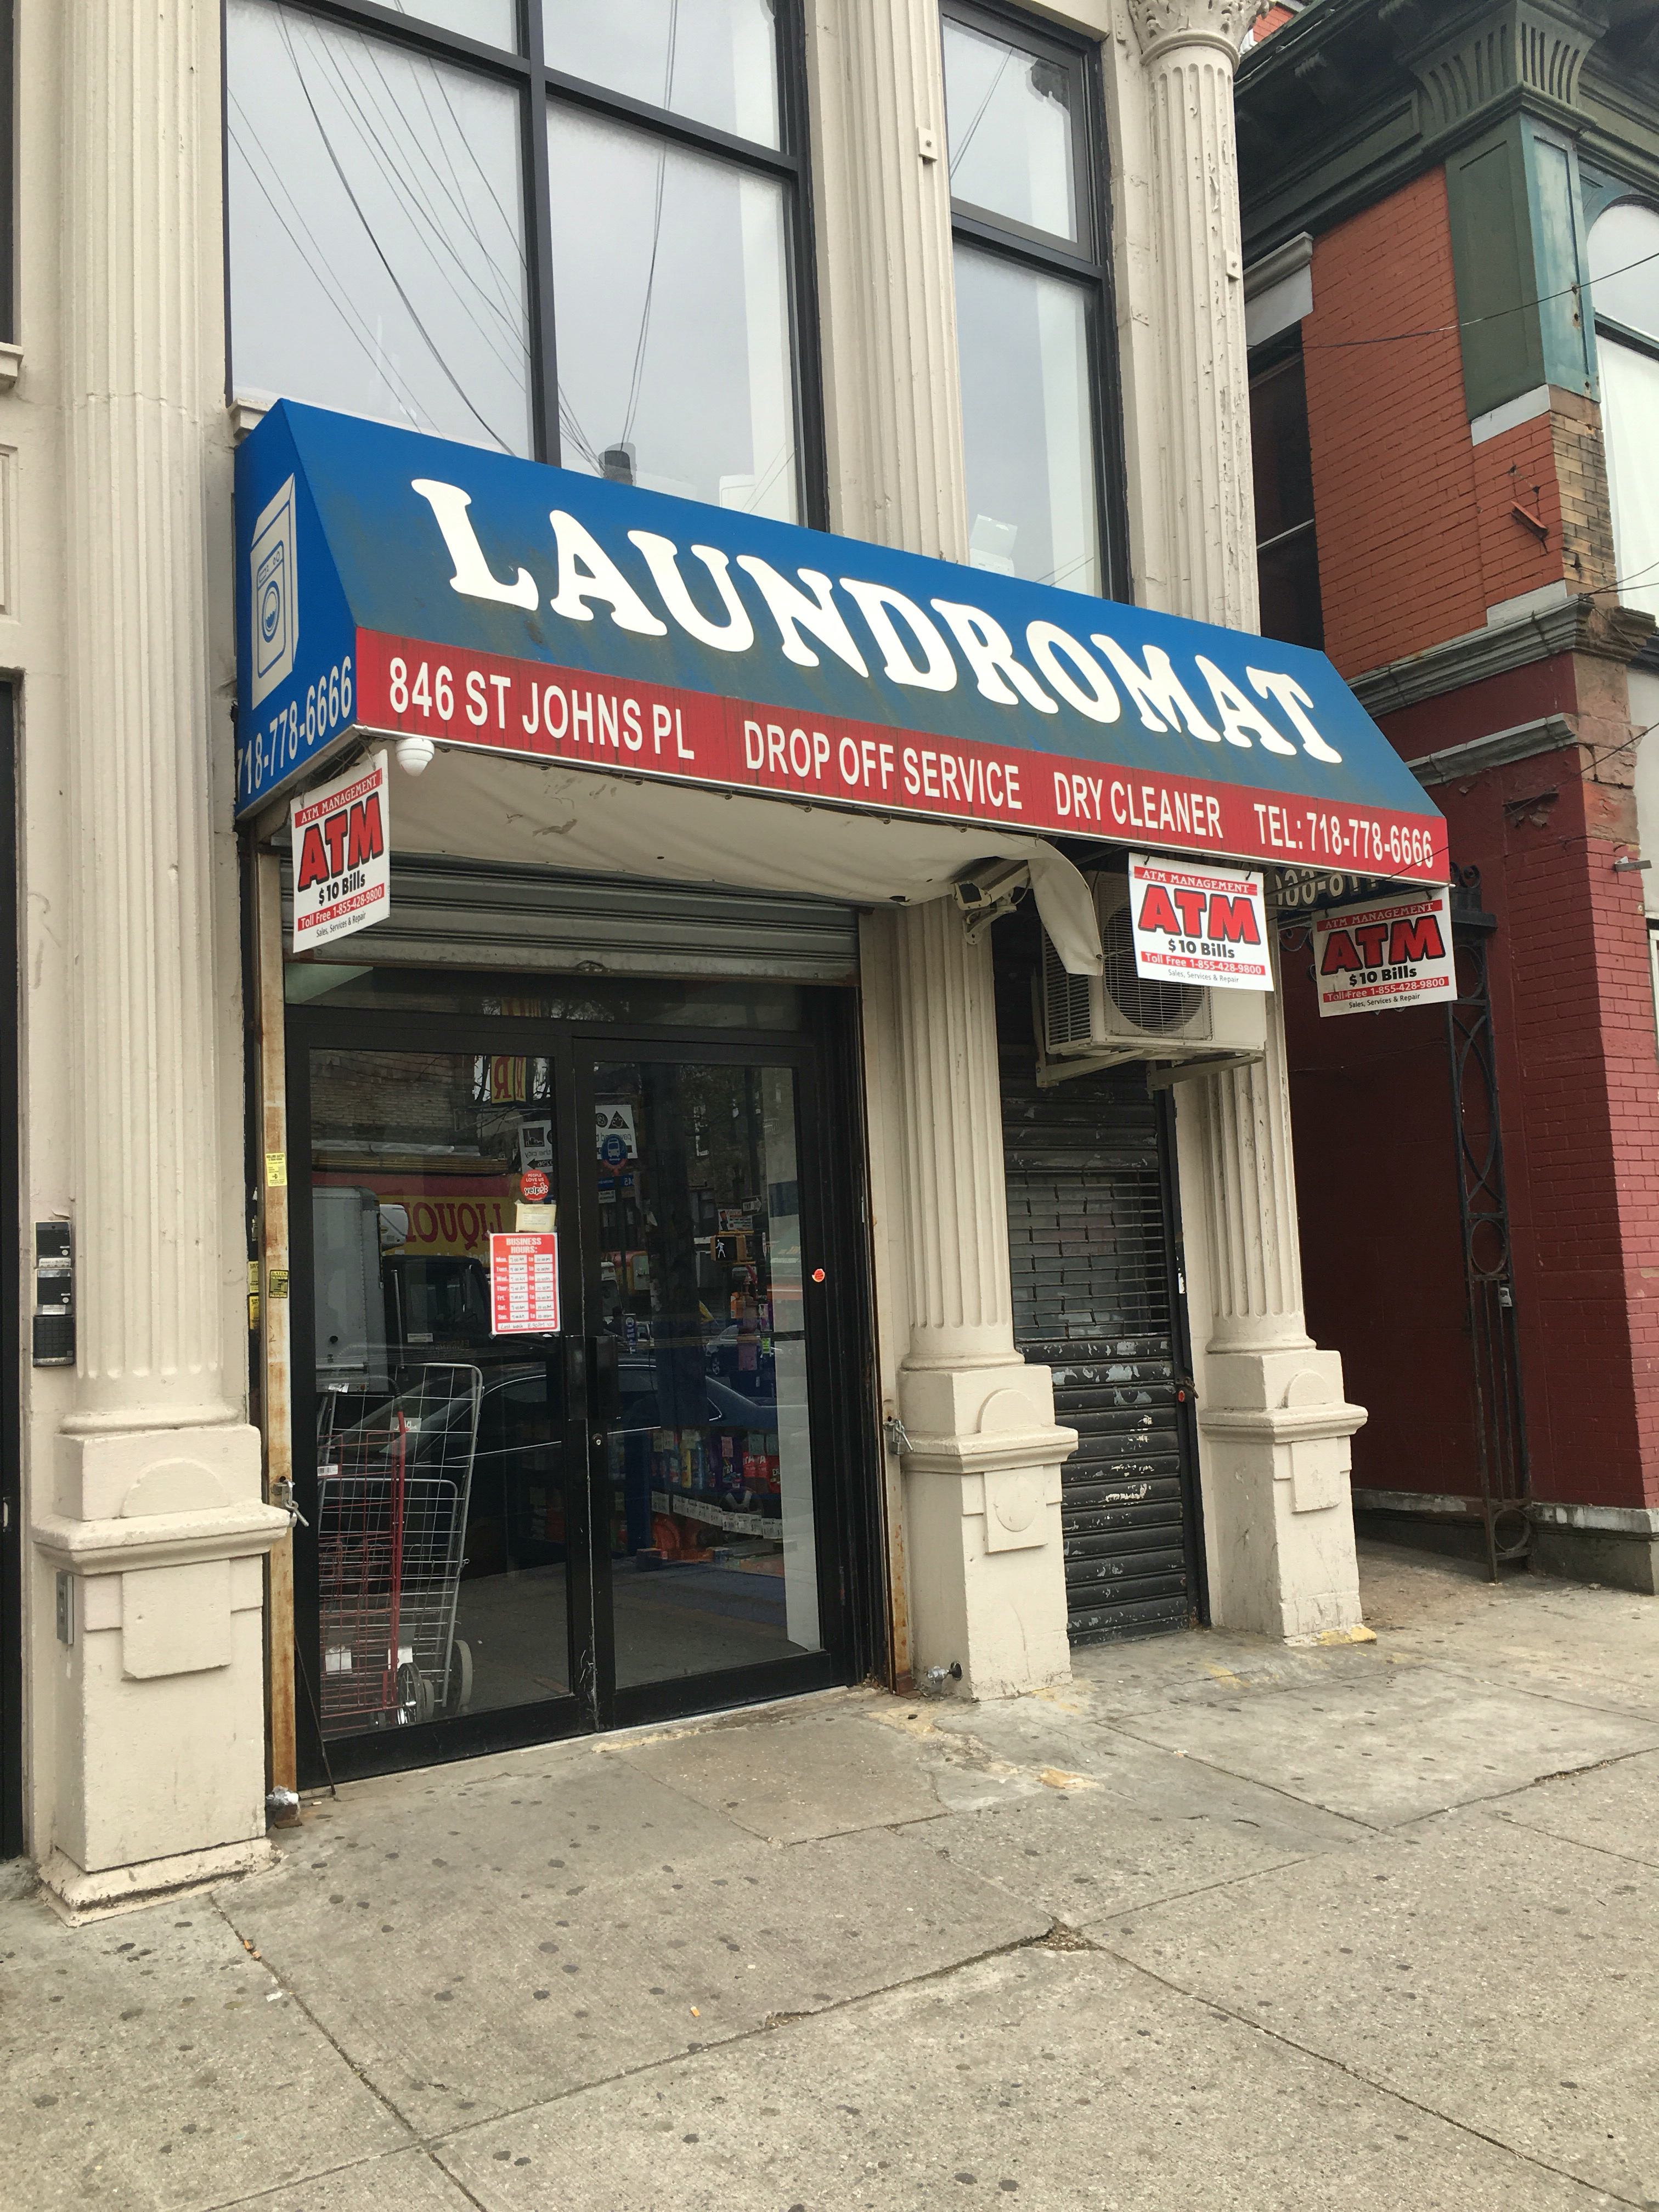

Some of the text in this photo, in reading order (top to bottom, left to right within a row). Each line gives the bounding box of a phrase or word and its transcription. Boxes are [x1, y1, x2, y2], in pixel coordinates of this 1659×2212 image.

[411, 478, 1342, 763] LAUNDROMAT
[390, 657, 694, 760] 846 ST JOHNS PL
[238, 656, 352, 803] 718-778-6666
[743, 720, 1022, 810] DROP OFF SERVICE
[302, 806, 319, 823] ATM
[321, 774, 377, 814] MANAGEMENT
[1054, 772, 1223, 839] DRY CLEANER
[298, 791, 383, 892] ATM
[342, 870, 365, 895] Bills
[1143, 870, 1249, 894] ATM MANAGEMENT
[301, 886, 382, 929] Toll Free 1-855-428-9800
[1138, 884, 1261, 945] ATM
[1324, 902, 1434, 929] ATM MANAGEMENT
[330, 919, 347, 933] Services
[352, 911, 366, 924] Repair
[1201, 943, 1235, 958] Bills
[1321, 915, 1446, 975] ATM
[1145, 953, 1261, 975] Toll Free 1-855-428-9800
[1169, 969, 1186, 978] Sales,
[1187, 971, 1211, 980] Services
[1220, 974, 1239, 983] Repair
[1381, 966, 1417, 981] Bills
[1370, 978, 1445, 995] 1-855-428-9800
[1367, 997, 1391, 1006] Services
[1400, 994, 1420, 1002] Repair
[524, 1186, 540, 1195] yelp
[511, 1246, 538, 1254] HOURS:
